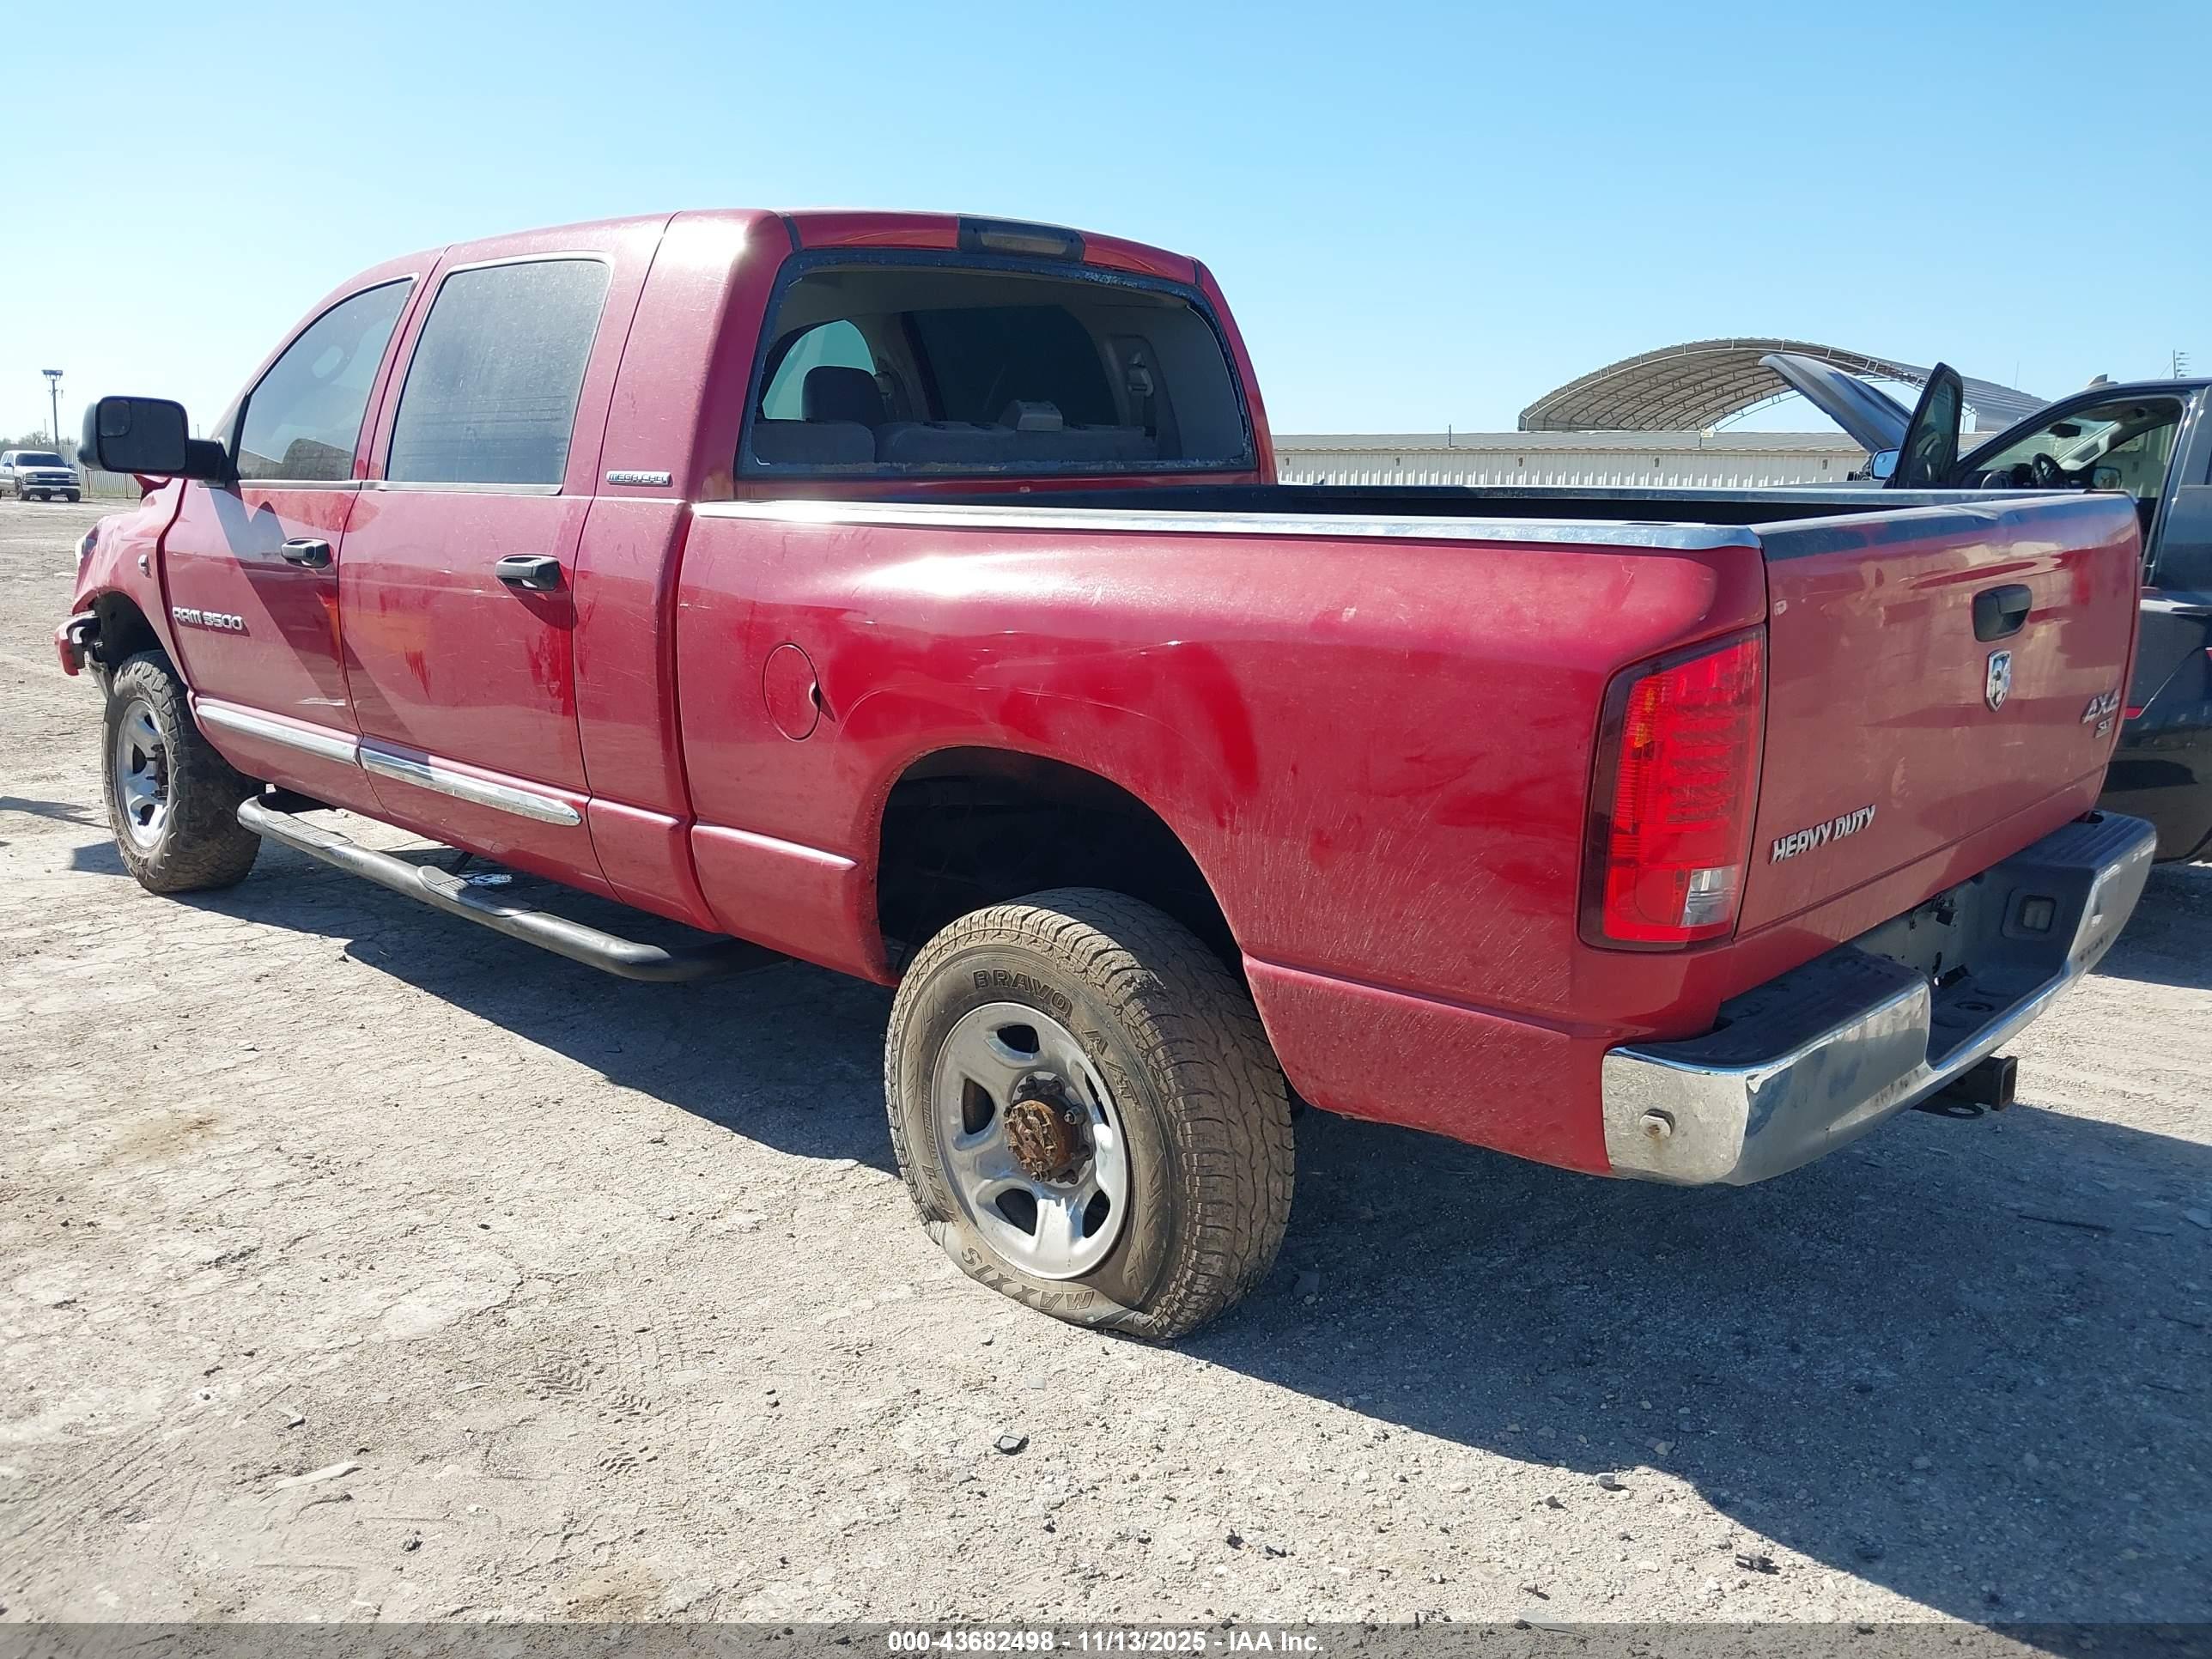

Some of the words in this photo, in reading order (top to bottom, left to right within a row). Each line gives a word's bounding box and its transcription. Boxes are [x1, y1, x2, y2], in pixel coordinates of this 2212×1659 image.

[173, 606, 203, 624] RAM
[203, 611, 243, 631] 3500
[1769, 821, 1832, 865] HEAVY
[1832, 804, 1876, 841] DUTY
[973, 968, 1073, 1017] BRAVO
[961, 1247, 1095, 1312] MAXXIS
